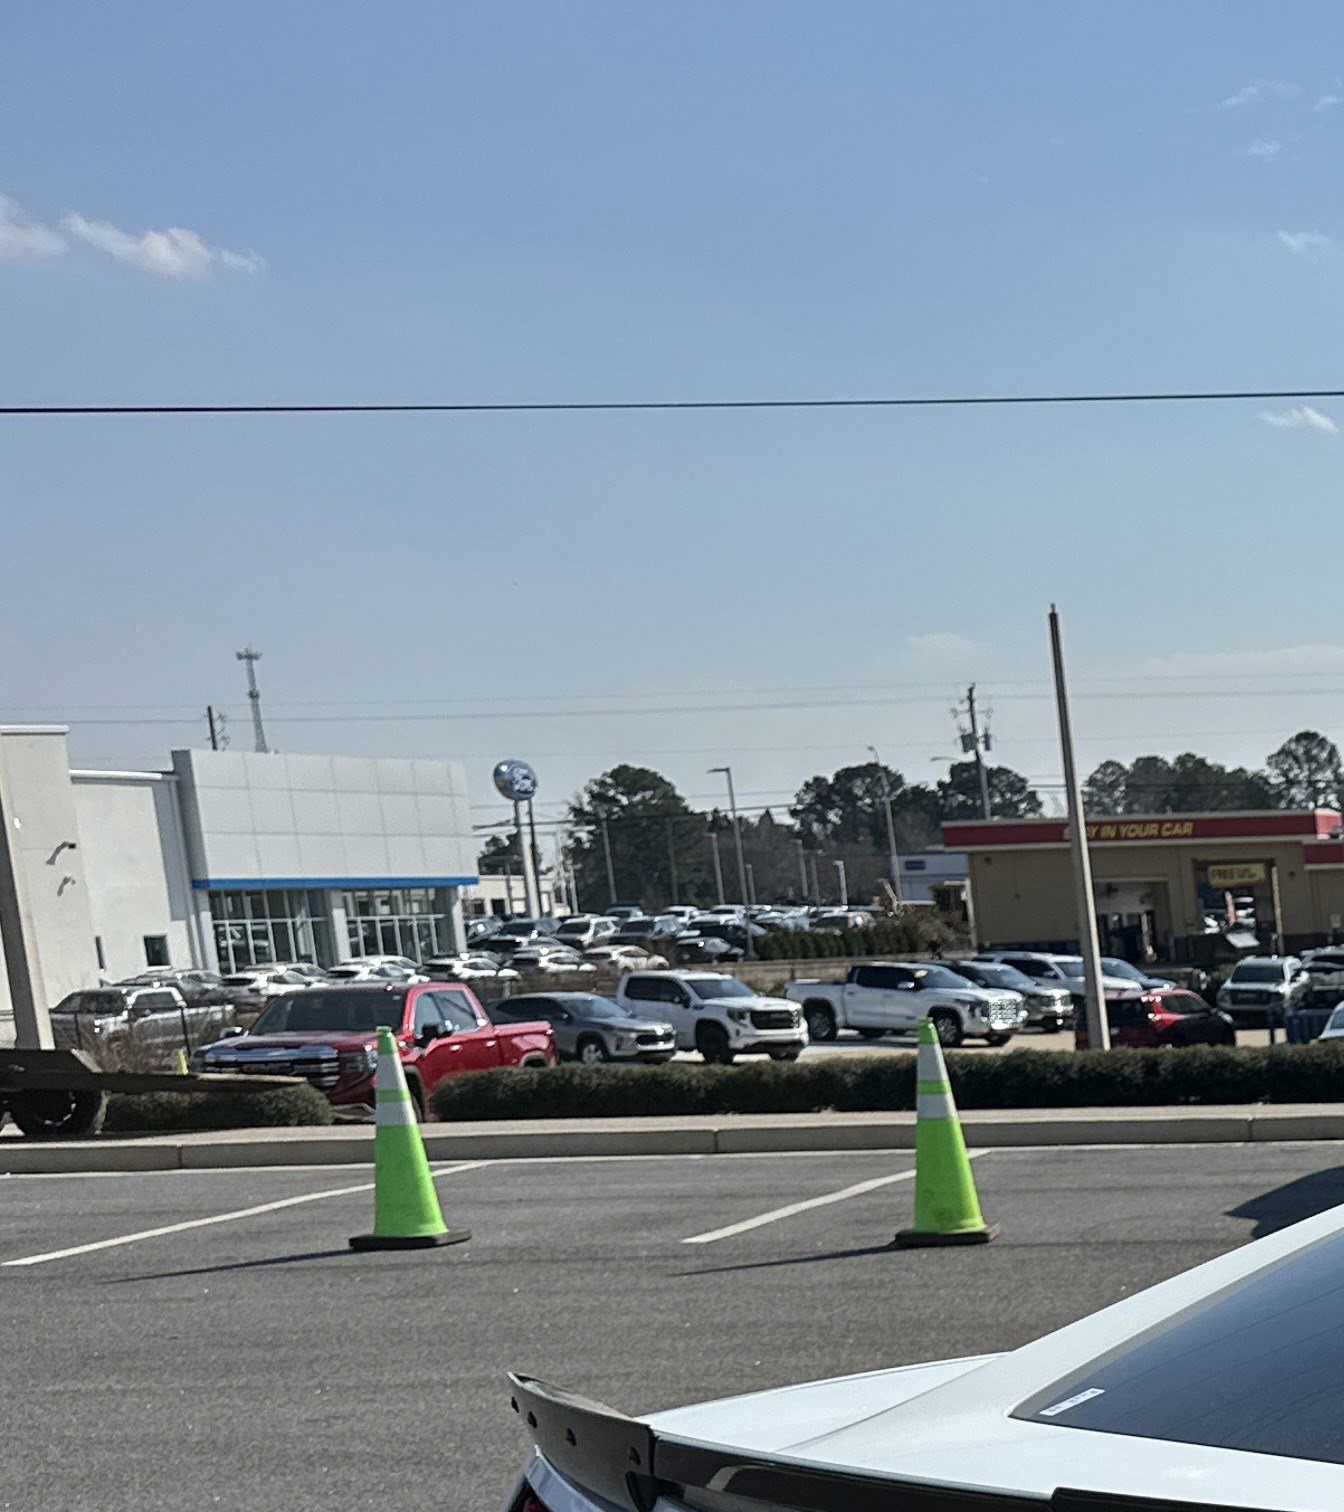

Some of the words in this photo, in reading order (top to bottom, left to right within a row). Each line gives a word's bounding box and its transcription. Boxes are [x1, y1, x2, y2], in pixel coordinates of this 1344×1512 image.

[1100, 825, 1117, 838] IN
[1120, 823, 1159, 838] YOUR
[1161, 821, 1193, 836] CAR
